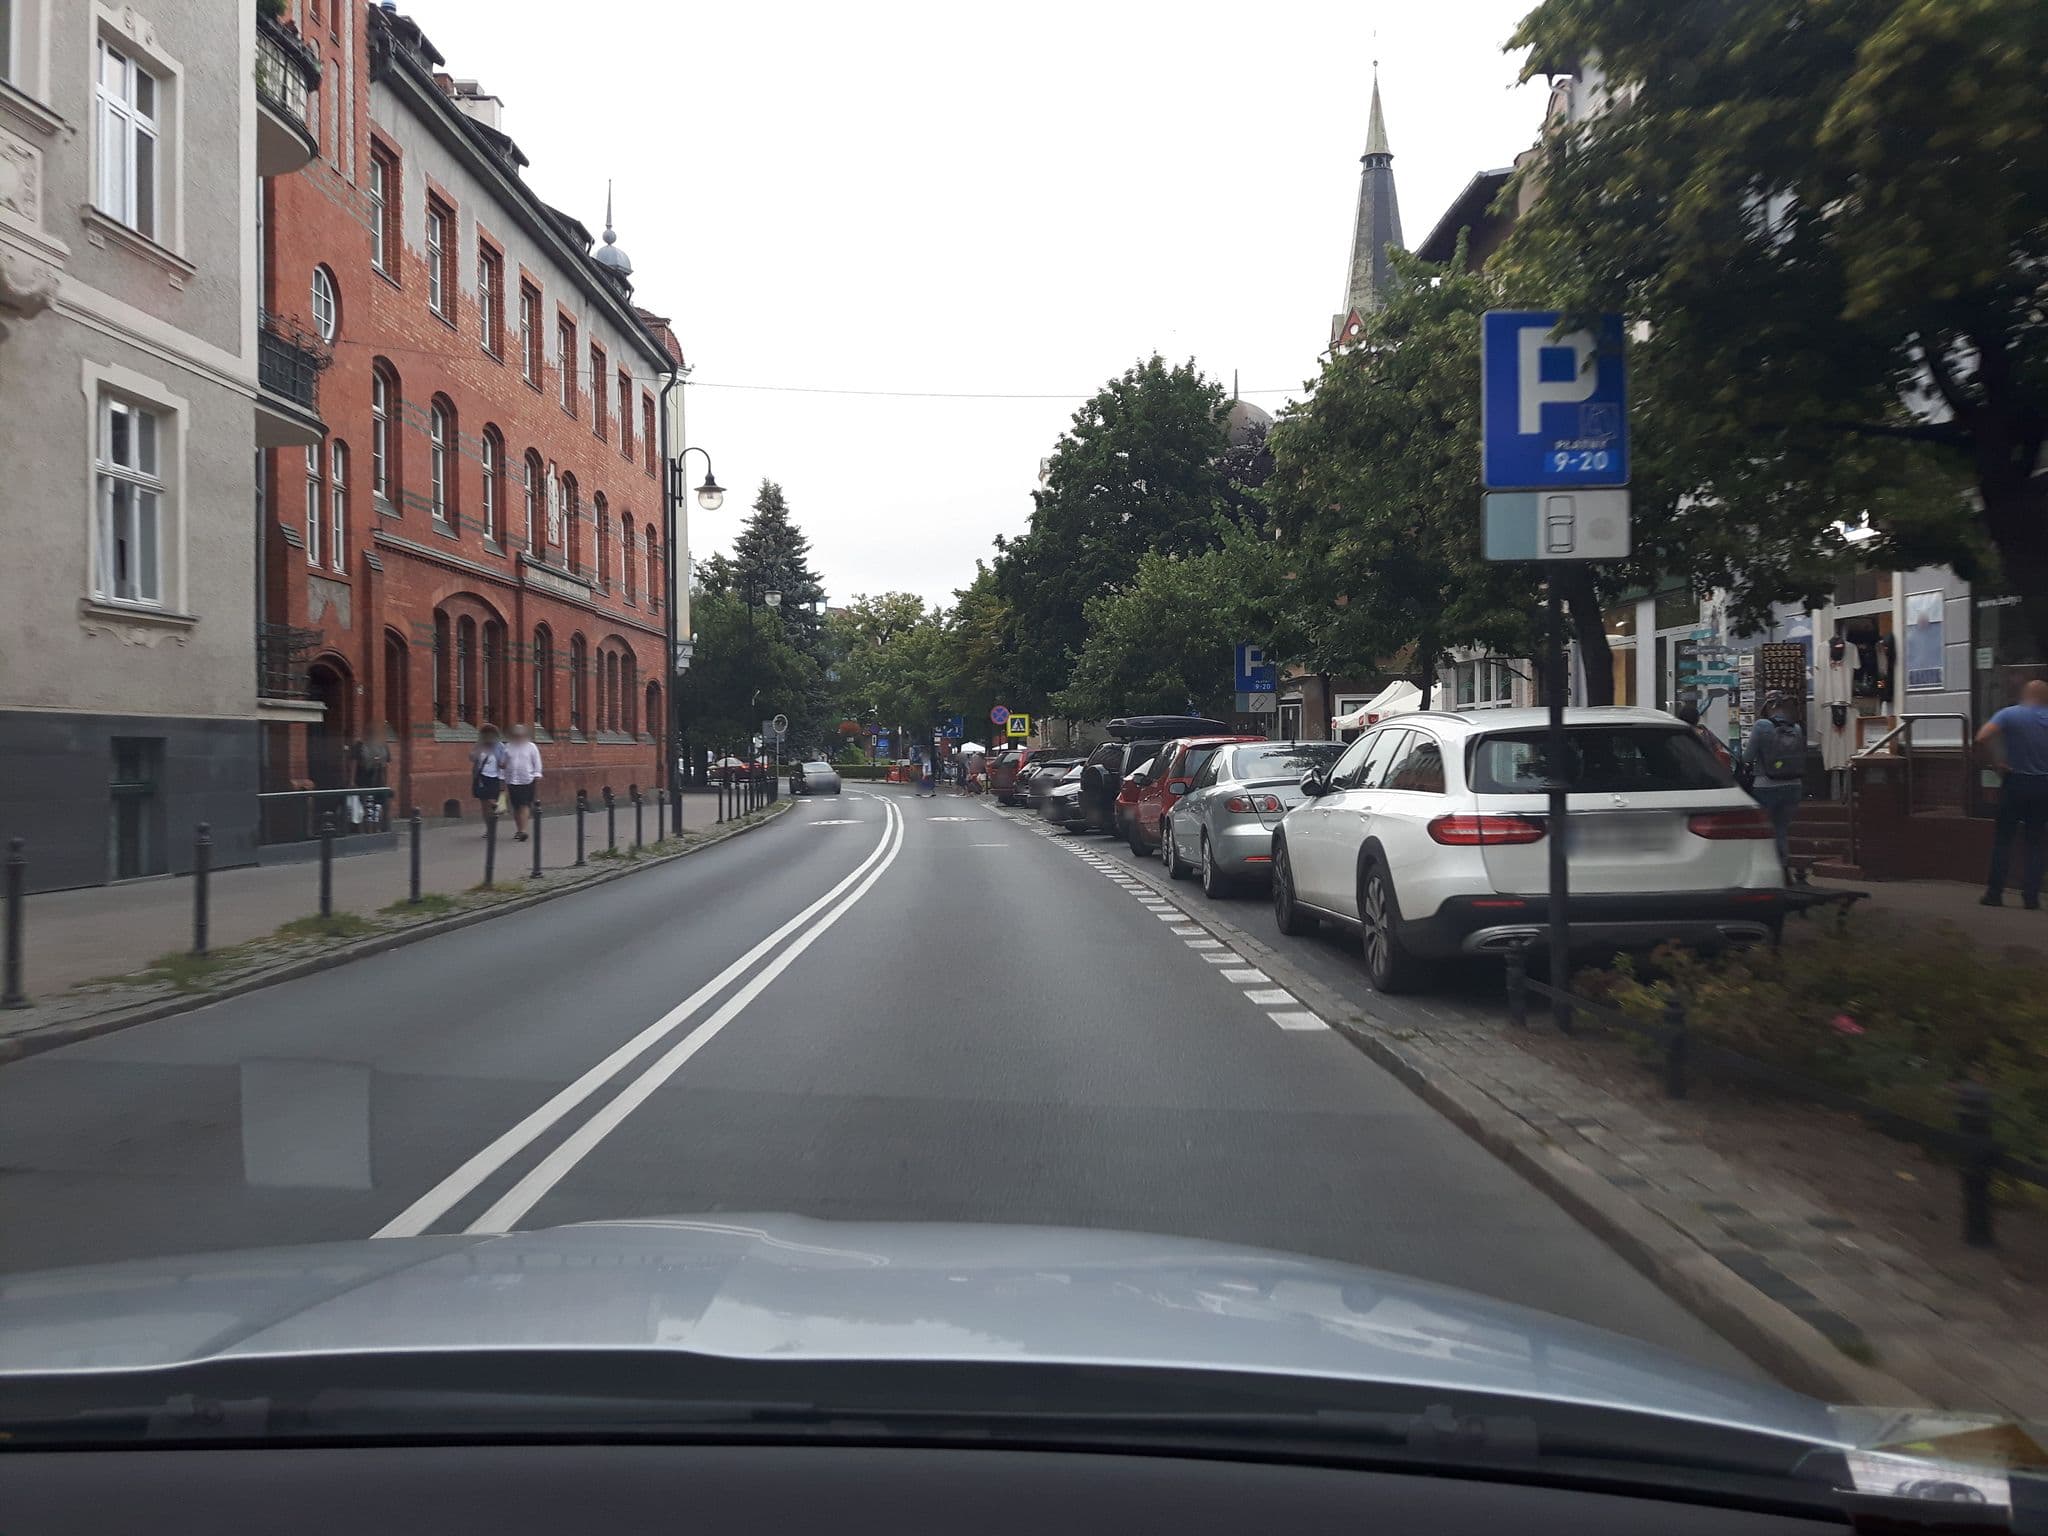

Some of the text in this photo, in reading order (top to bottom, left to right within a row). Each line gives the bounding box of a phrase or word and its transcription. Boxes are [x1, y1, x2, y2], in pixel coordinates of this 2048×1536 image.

[1518, 327, 1597, 434] P
[1554, 451, 1609, 472] 9-20
[1245, 645, 1266, 677] P
